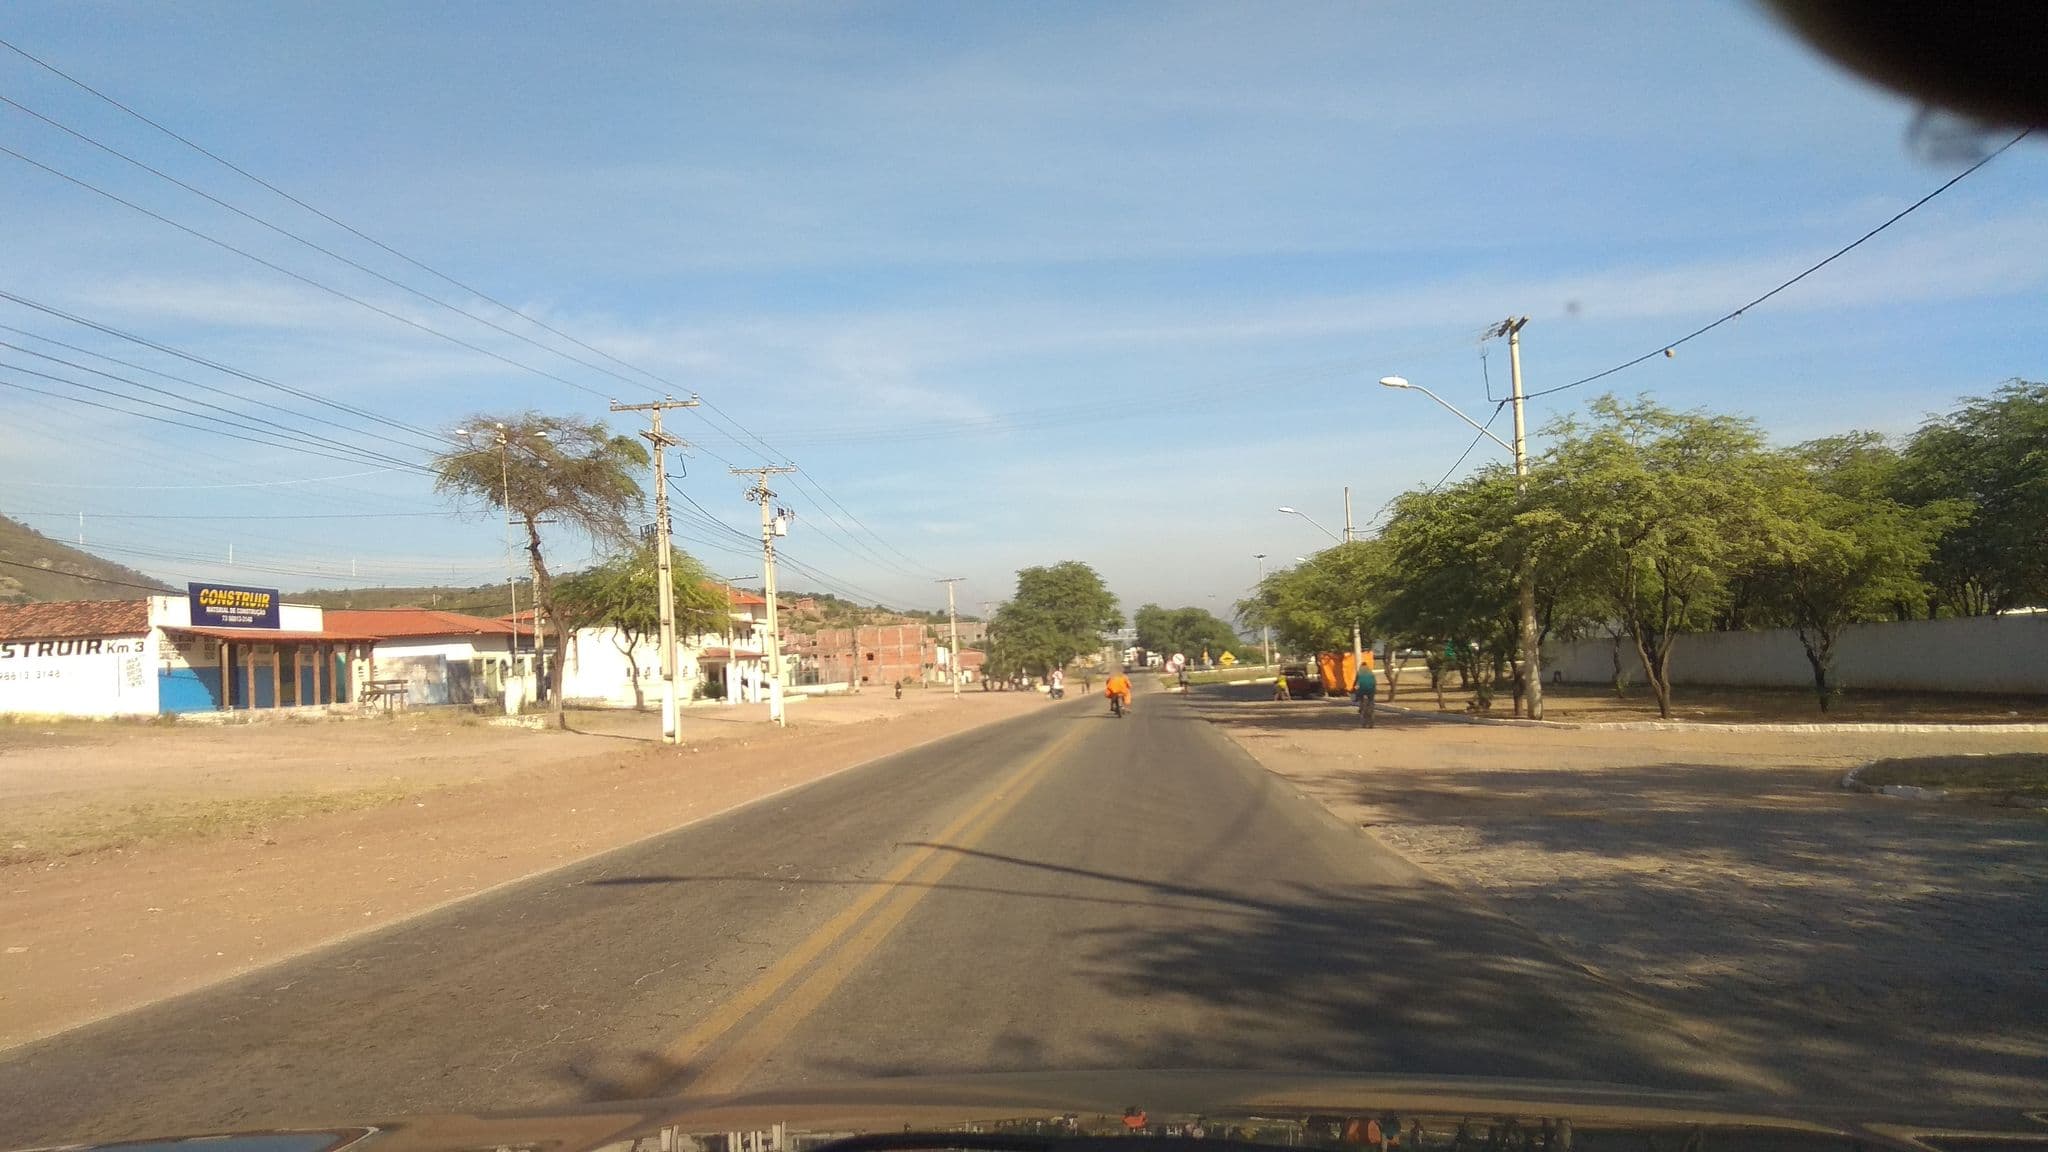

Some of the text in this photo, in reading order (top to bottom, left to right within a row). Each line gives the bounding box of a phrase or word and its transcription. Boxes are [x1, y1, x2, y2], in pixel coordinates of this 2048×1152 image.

[200, 588, 271, 608] CONSTRUIR
[1, 640, 145, 658] STRUIR Km 3
